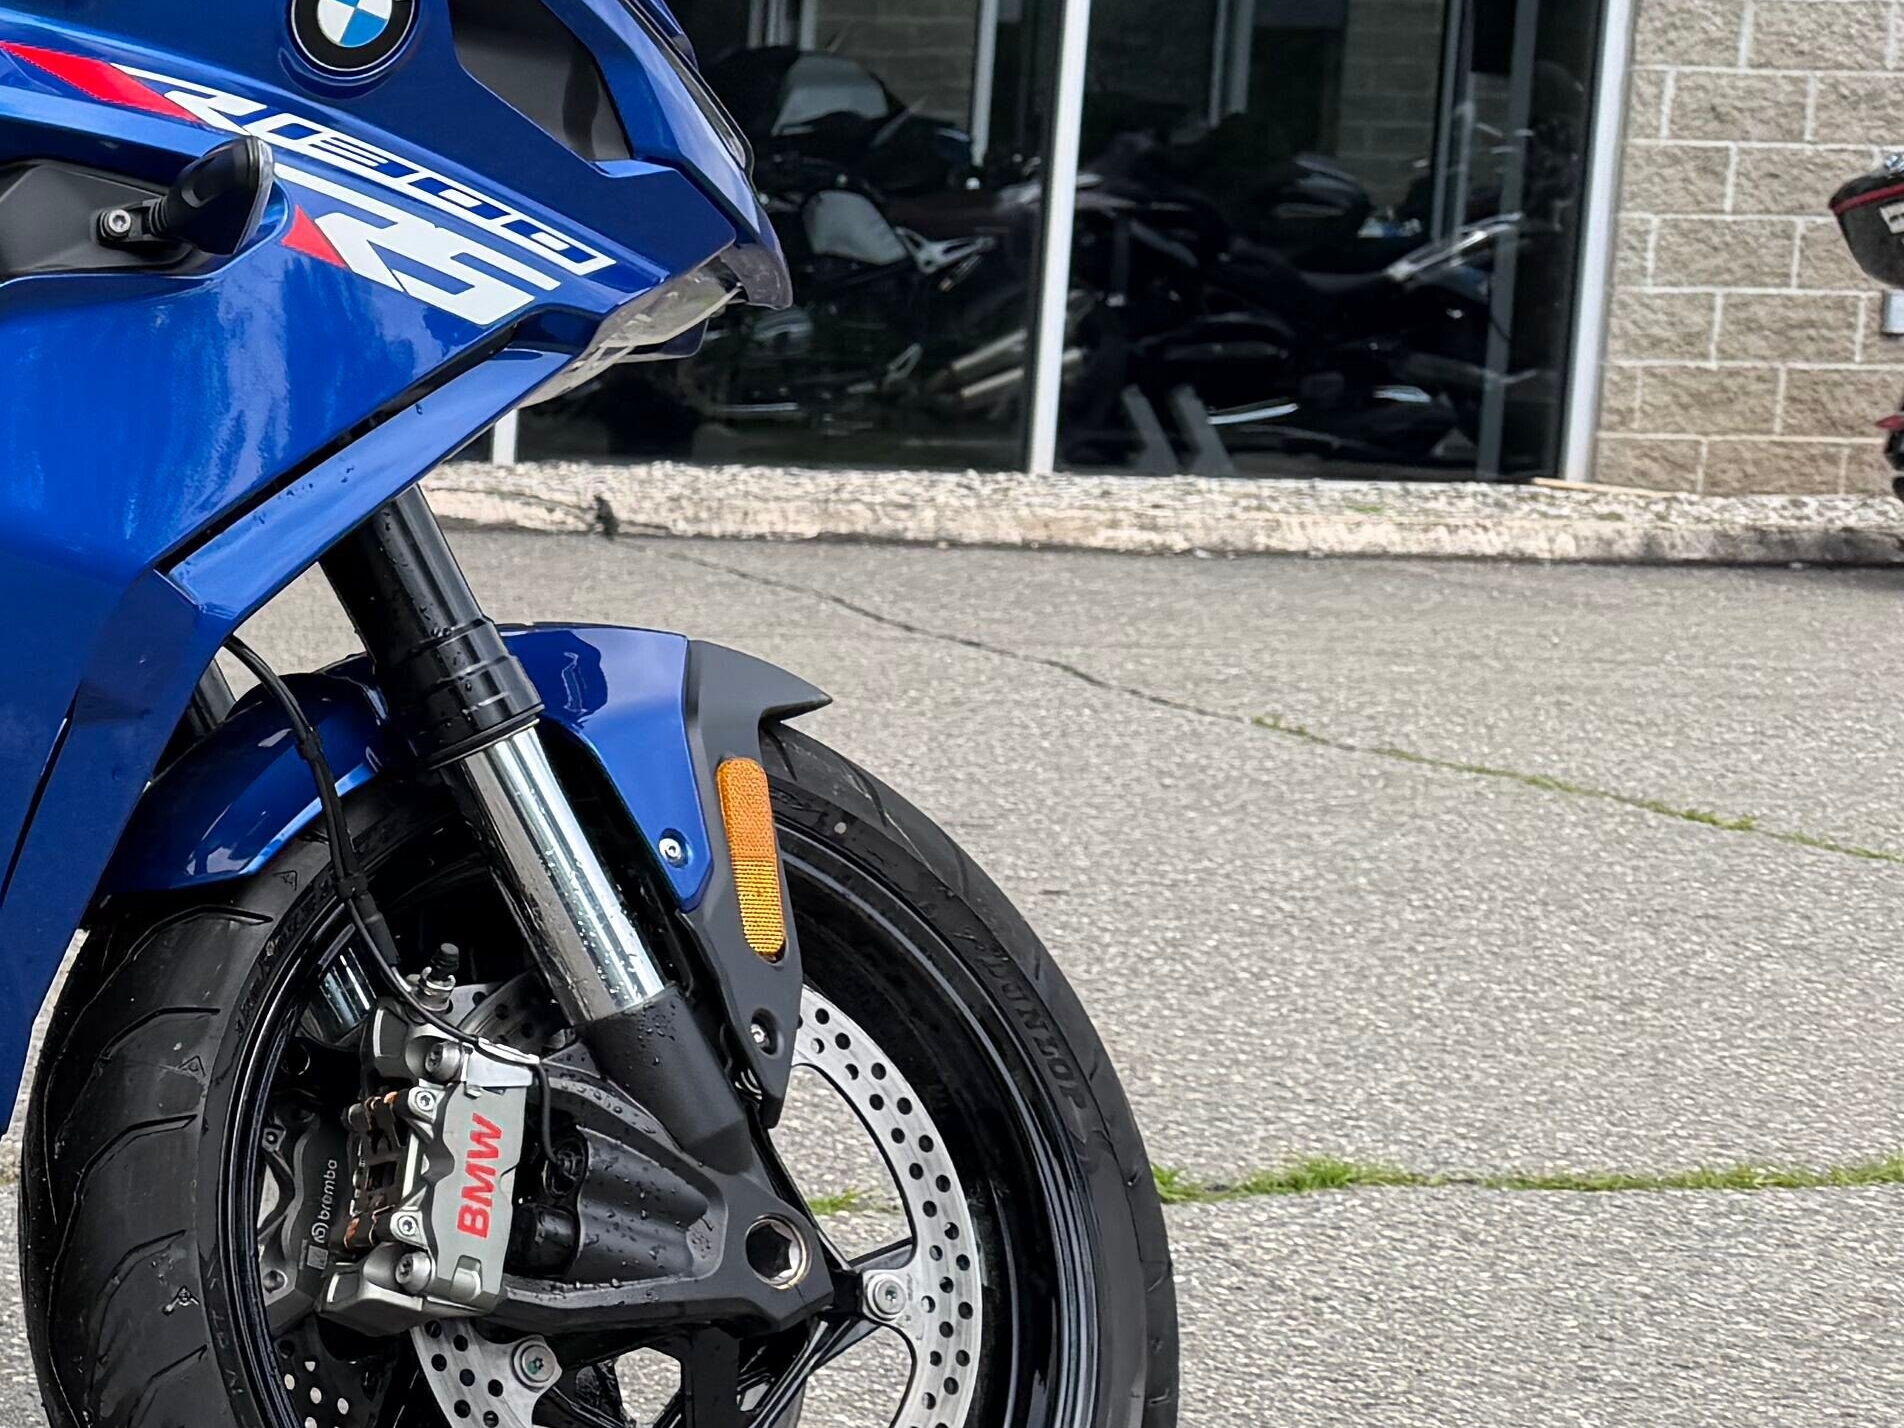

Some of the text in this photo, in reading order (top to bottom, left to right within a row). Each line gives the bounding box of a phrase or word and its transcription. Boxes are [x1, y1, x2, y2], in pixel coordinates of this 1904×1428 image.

[273, 162, 563, 326] RS
[978, 956, 1087, 1110] DUNLOP
[456, 1112, 503, 1239] BMW
